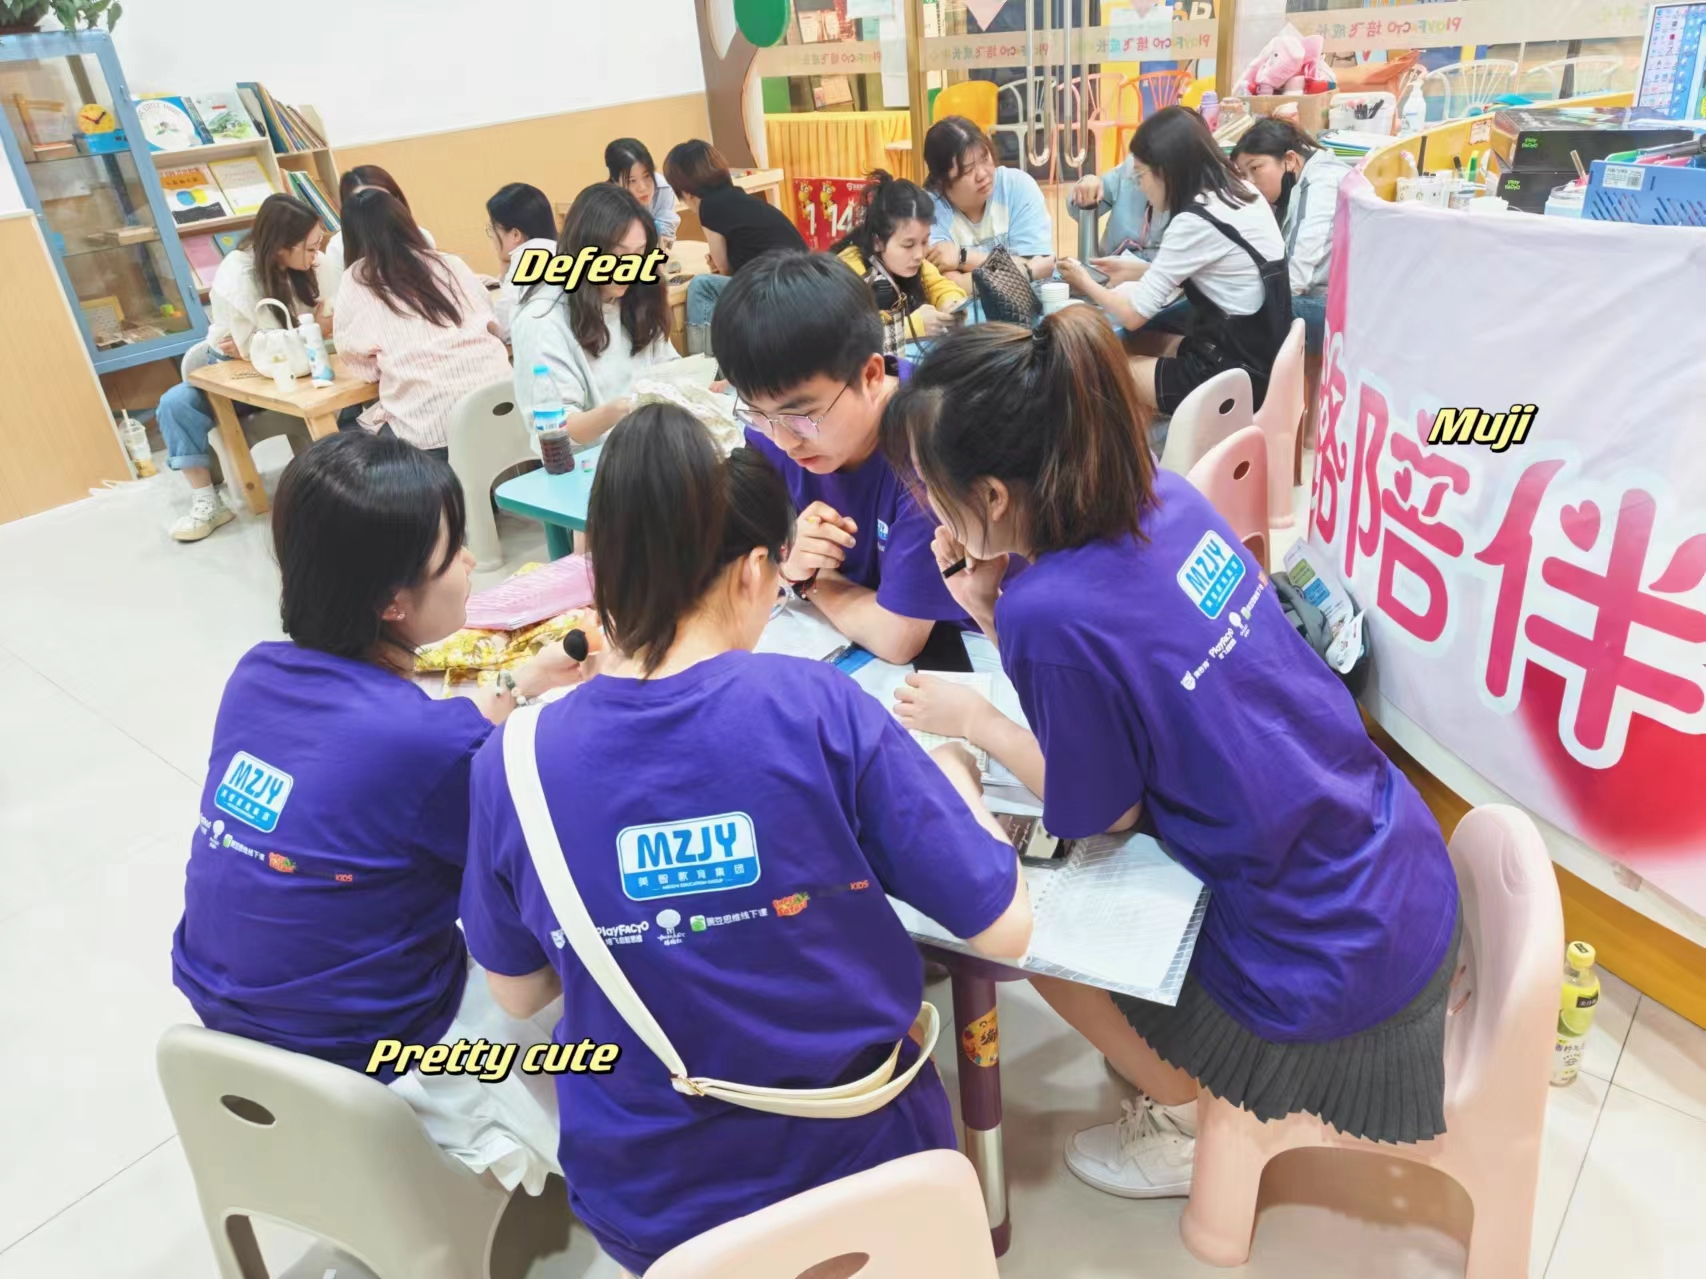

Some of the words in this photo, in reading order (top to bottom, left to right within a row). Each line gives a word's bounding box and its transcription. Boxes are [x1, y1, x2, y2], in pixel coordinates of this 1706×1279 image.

[1185, 538, 1225, 596] MZJY
[229, 760, 285, 806] MZJY
[637, 822, 738, 869] MZJY
[335, 873, 353, 883] KIDS
[637, 863, 746, 888] 美智教育集团
[850, 880, 869, 891] KIDS
